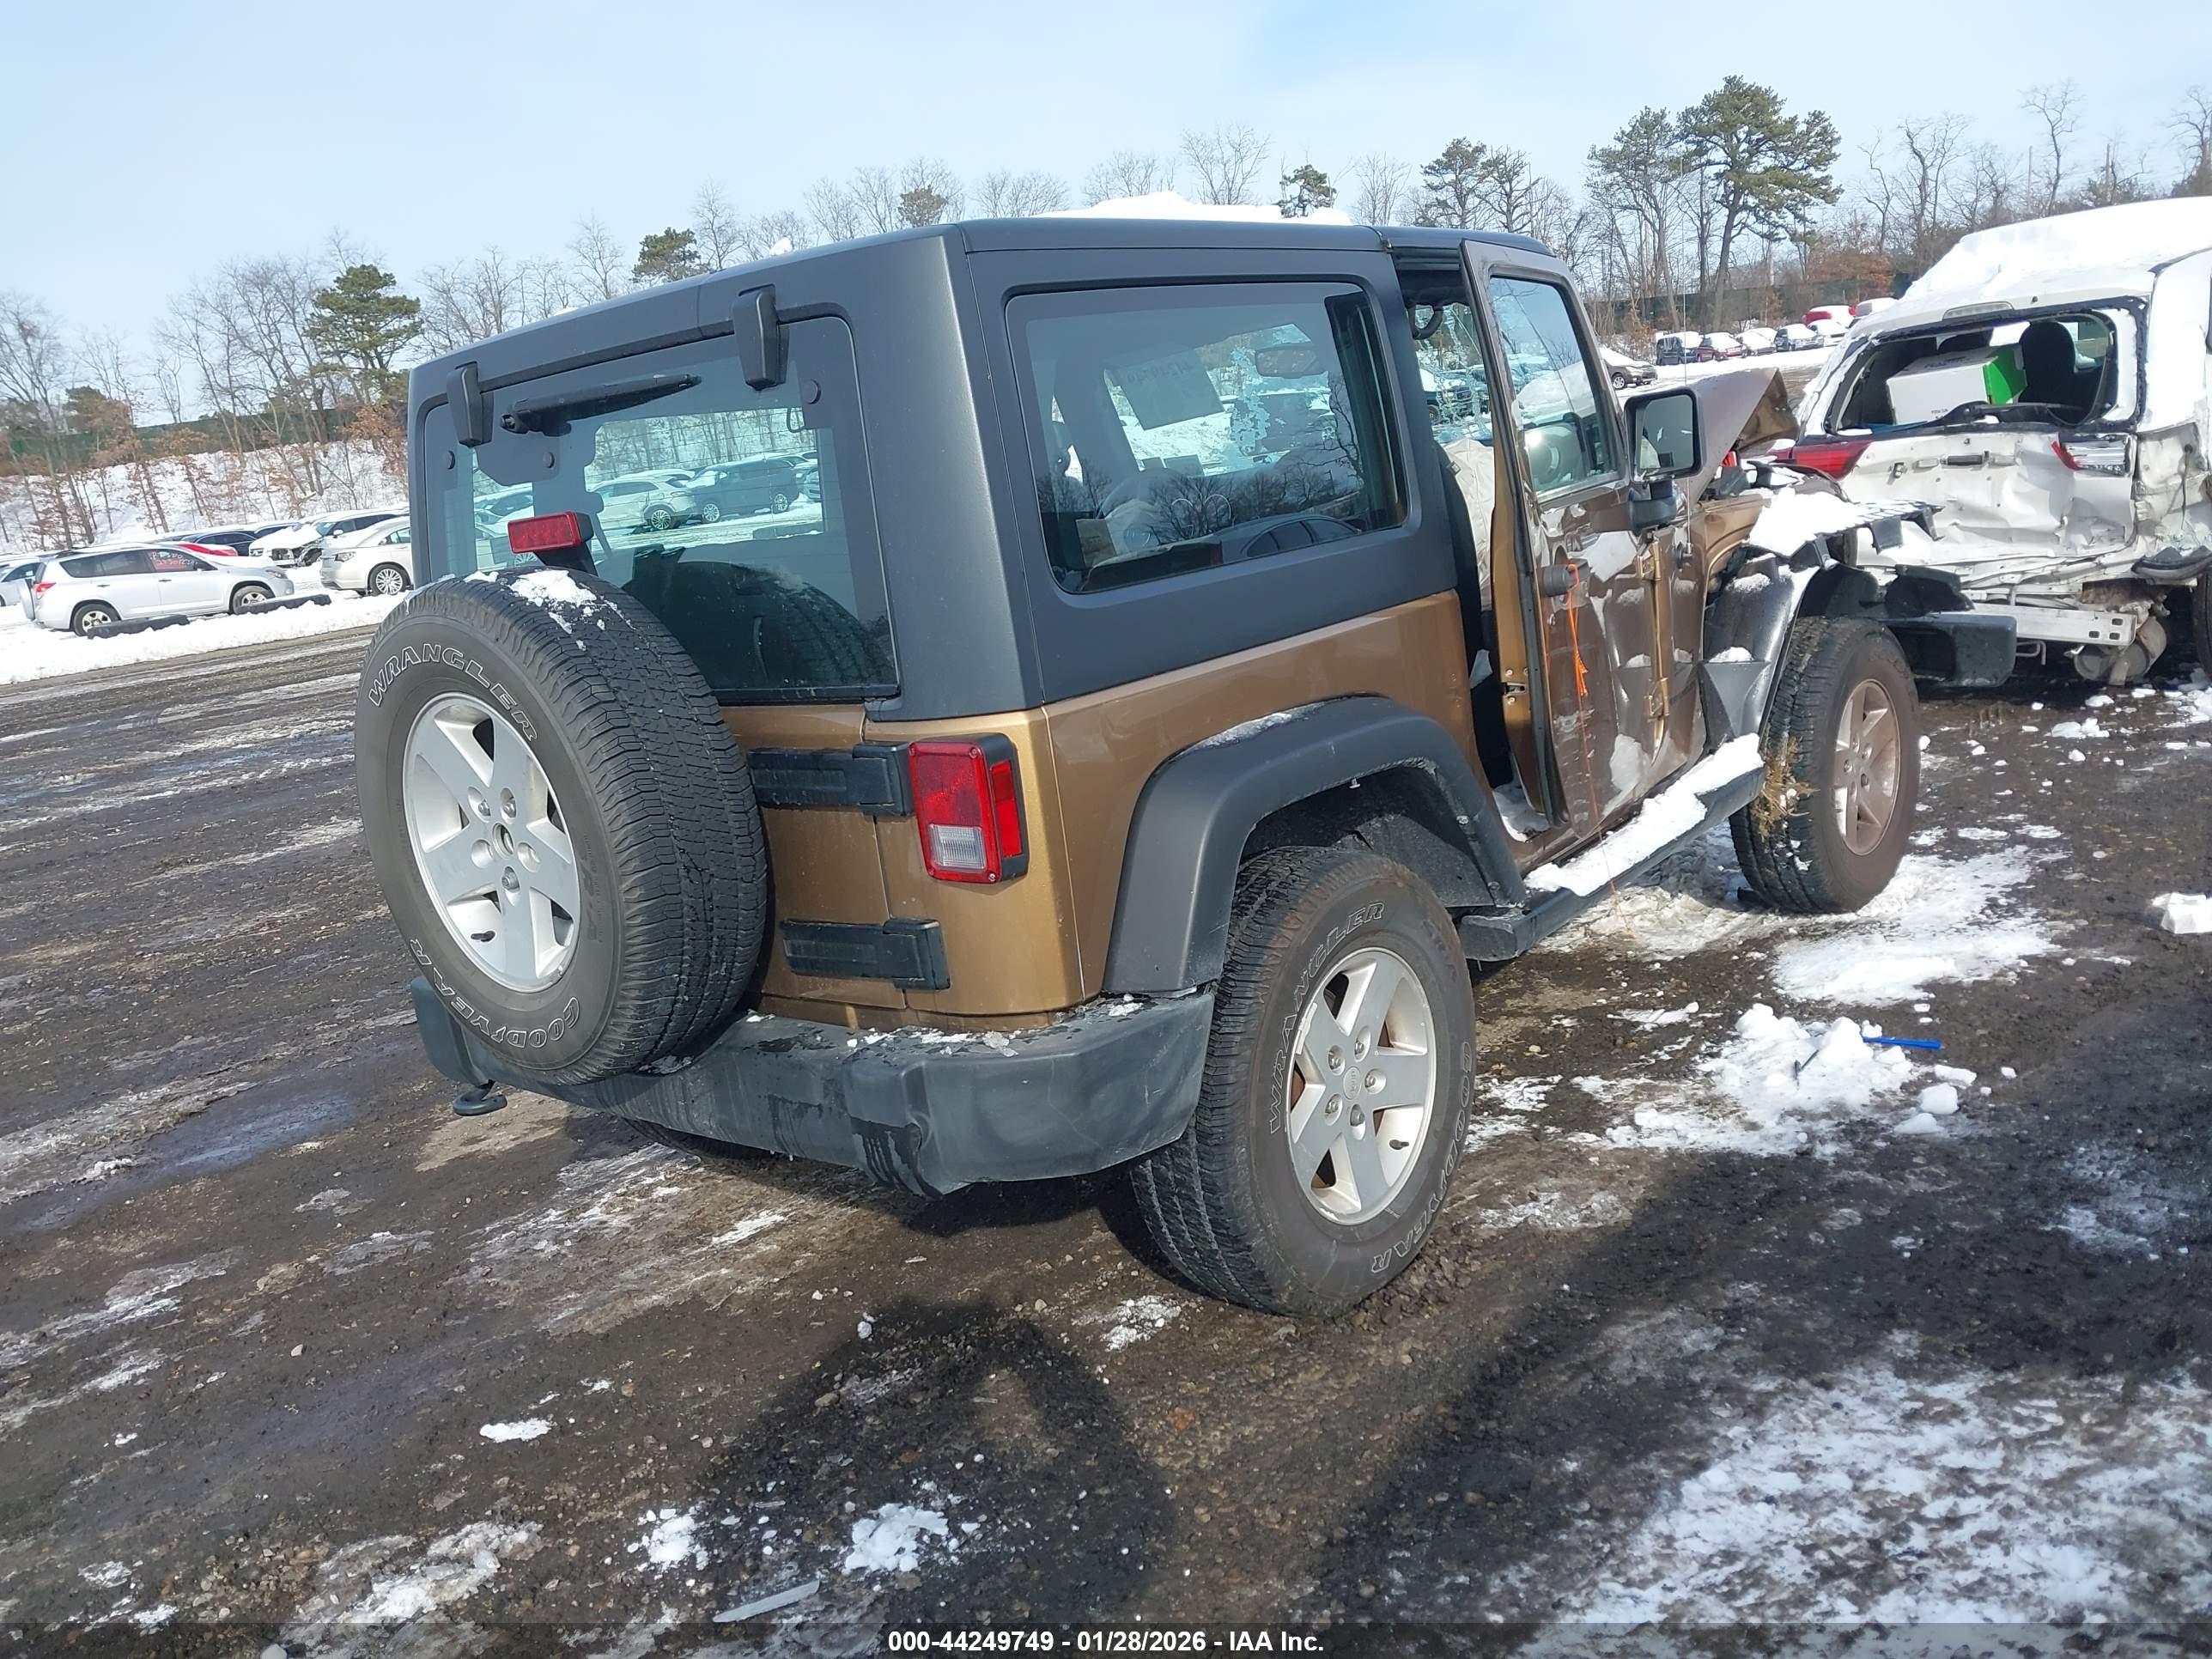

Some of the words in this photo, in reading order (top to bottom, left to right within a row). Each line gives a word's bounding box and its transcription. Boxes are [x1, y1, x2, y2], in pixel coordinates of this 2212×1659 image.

[368, 642, 538, 742] WRANGLER
[409, 938, 580, 1049] GOODYEAR
[1269, 902, 1385, 1134] WRANGLER
[1370, 1040, 1473, 1274] GOODYEAR
